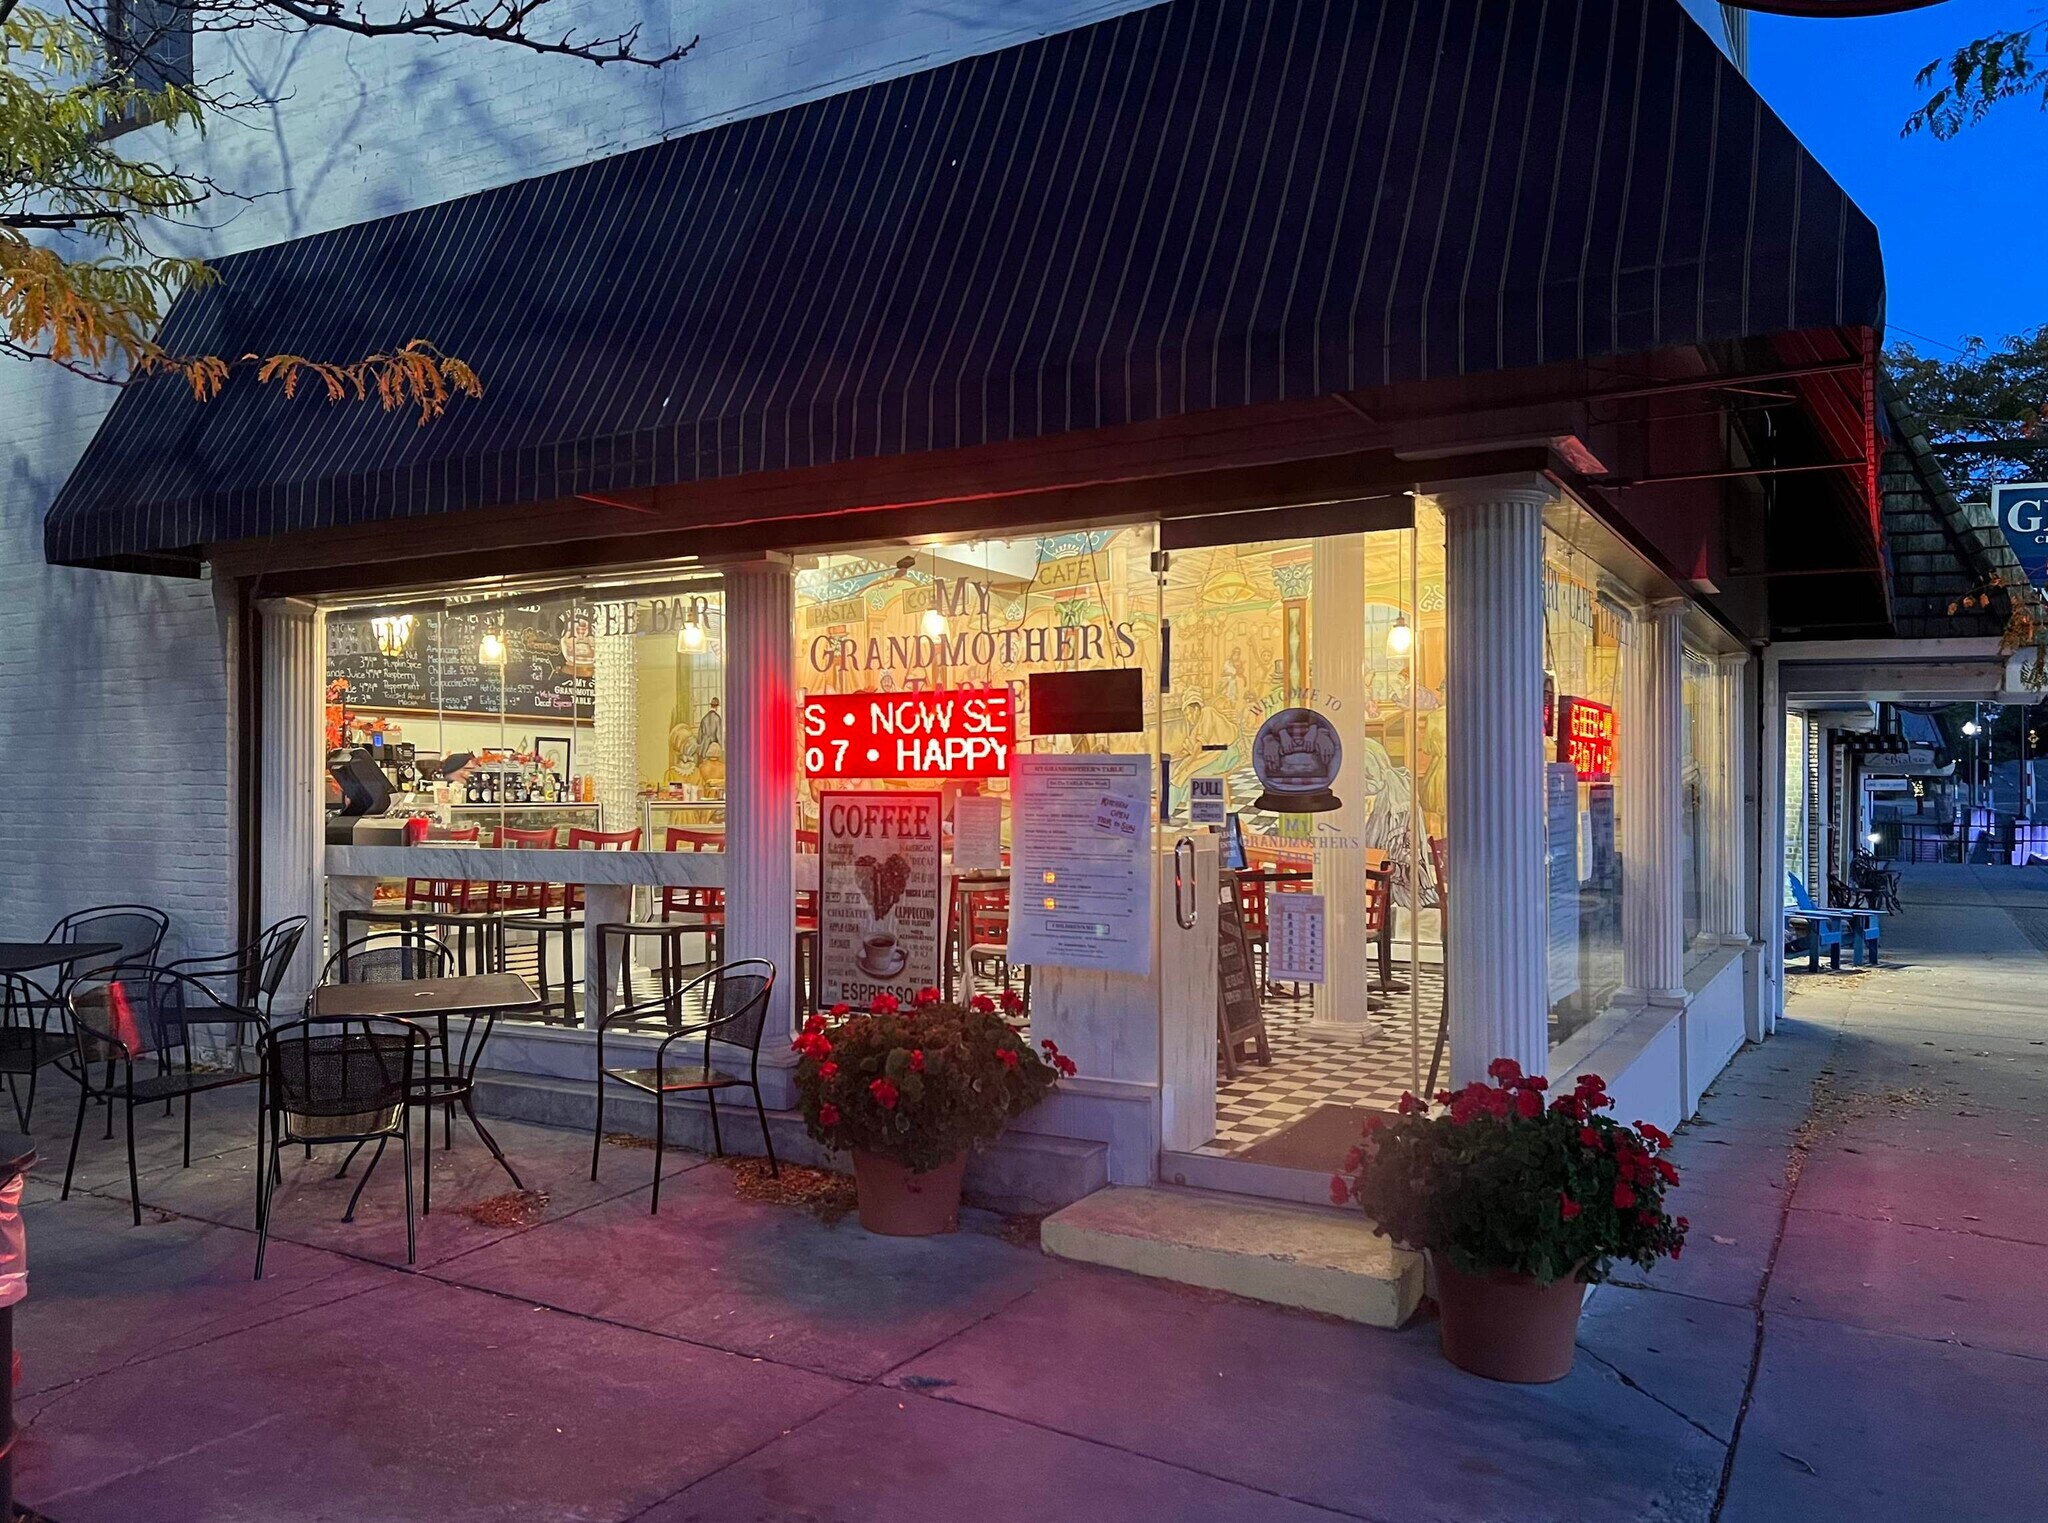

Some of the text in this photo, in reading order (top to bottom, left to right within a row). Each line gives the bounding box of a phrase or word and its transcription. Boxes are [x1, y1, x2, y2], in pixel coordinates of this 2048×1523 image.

[2007, 500, 2048, 532] G
[1039, 560, 1090, 585] CAFE
[934, 577, 994, 617] MY
[650, 596, 710, 632] BAR
[814, 605, 857, 624] PASTA
[810, 622, 1135, 672] GRANDMOTHER'S
[870, 701, 954, 734] NOW
[1250, 687, 1342, 717] WELCOME TO
[897, 737, 1007, 771] HAPPY
[1192, 781, 1221, 795] PULL
[830, 804, 932, 840] COFFEE
[1110, 810, 1130, 821] OPEN
